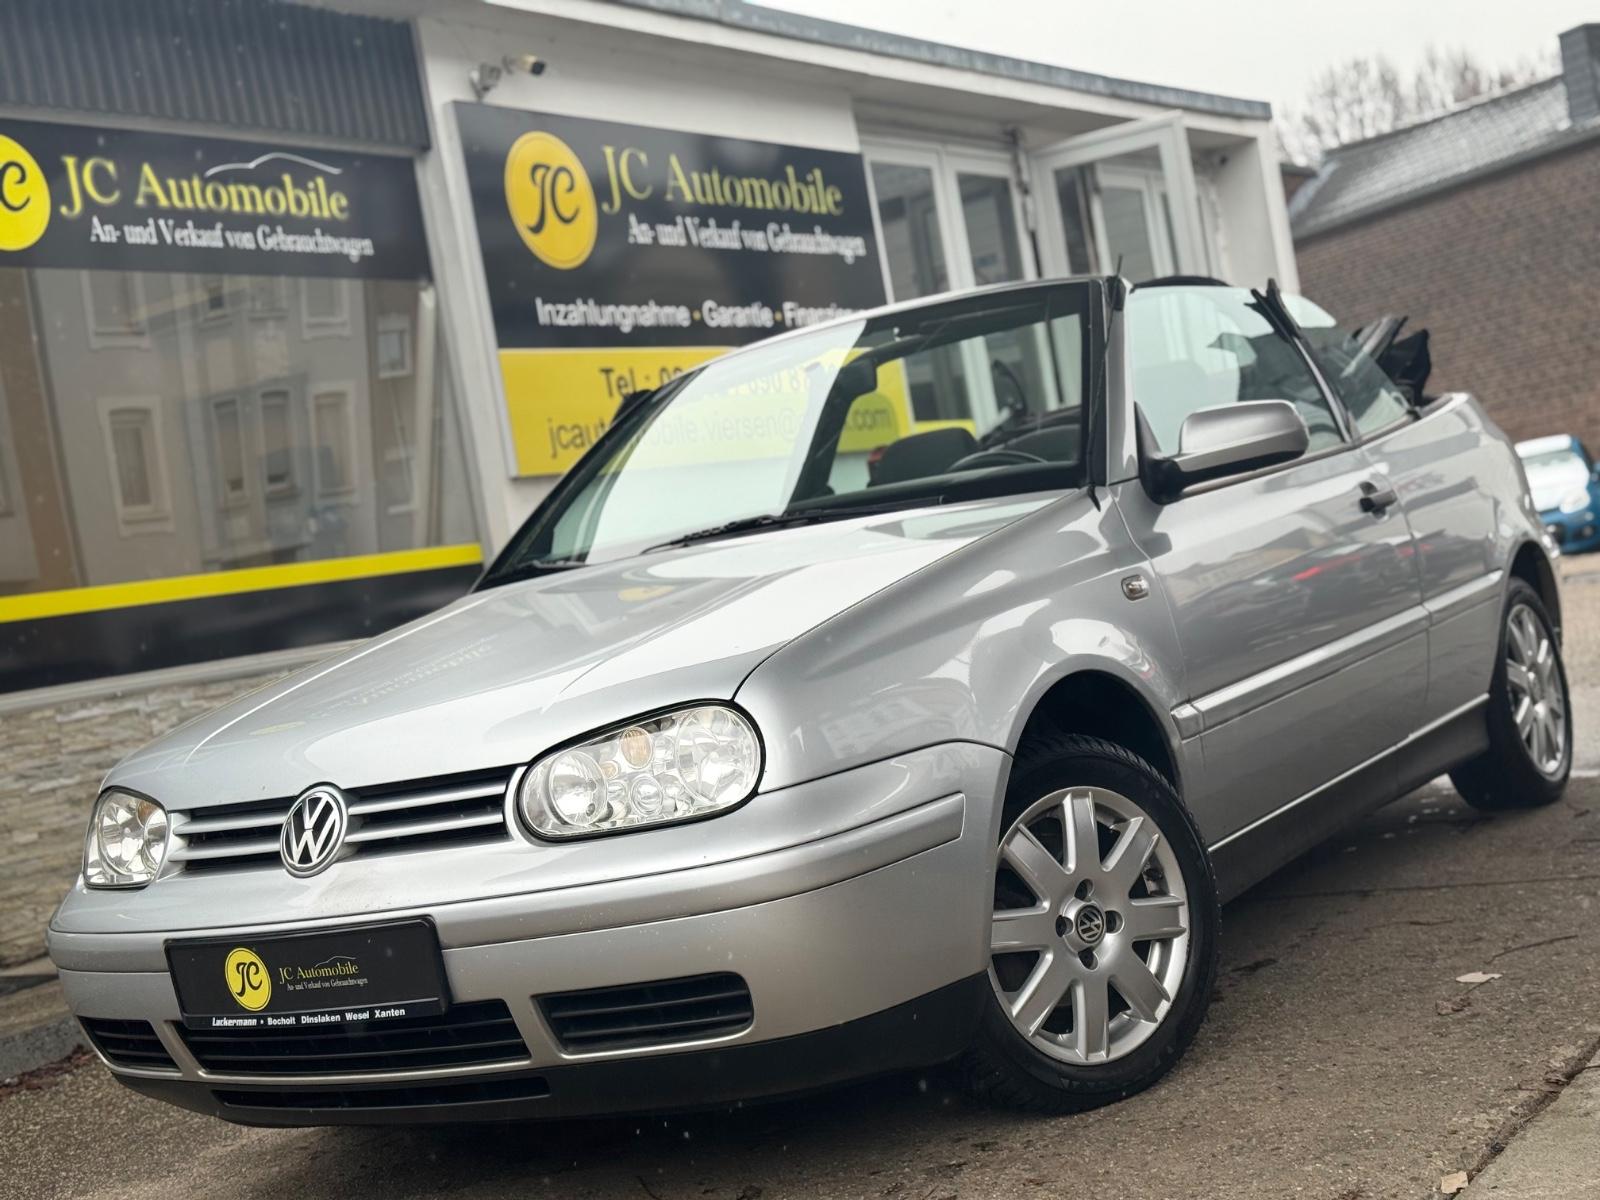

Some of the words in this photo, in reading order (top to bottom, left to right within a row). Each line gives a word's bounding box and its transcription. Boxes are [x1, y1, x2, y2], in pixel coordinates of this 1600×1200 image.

[60, 155, 120, 218] JC
[135, 162, 350, 221] Automobile
[527, 163, 580, 235] JC
[602, 145, 653, 214] JC
[666, 153, 844, 216] Automobile
[90, 215, 121, 244] An-
[123, 218, 158, 246] und
[161, 219, 224, 249] Verkauf
[225, 230, 256, 250] von
[257, 224, 374, 263] Gebrauchtwagen
[628, 214, 655, 244] An-
[656, 218, 686, 247] und
[688, 217, 741, 250] Verkauf
[741, 230, 768, 252] von
[768, 222, 867, 264] Gebrauchtwagen
[535, 297, 691, 333] Inzahlungnahme
[701, 301, 774, 329] Garantie
[235, 960, 263, 997] JC
[279, 967, 294, 984] JC
[297, 961, 359, 979] Automobile
[267, 1016, 296, 1025] Bocholt
[301, 1014, 341, 1024] Dinslaken
[345, 1010, 370, 1021] Wesel
[374, 1008, 405, 1018] Xanten
